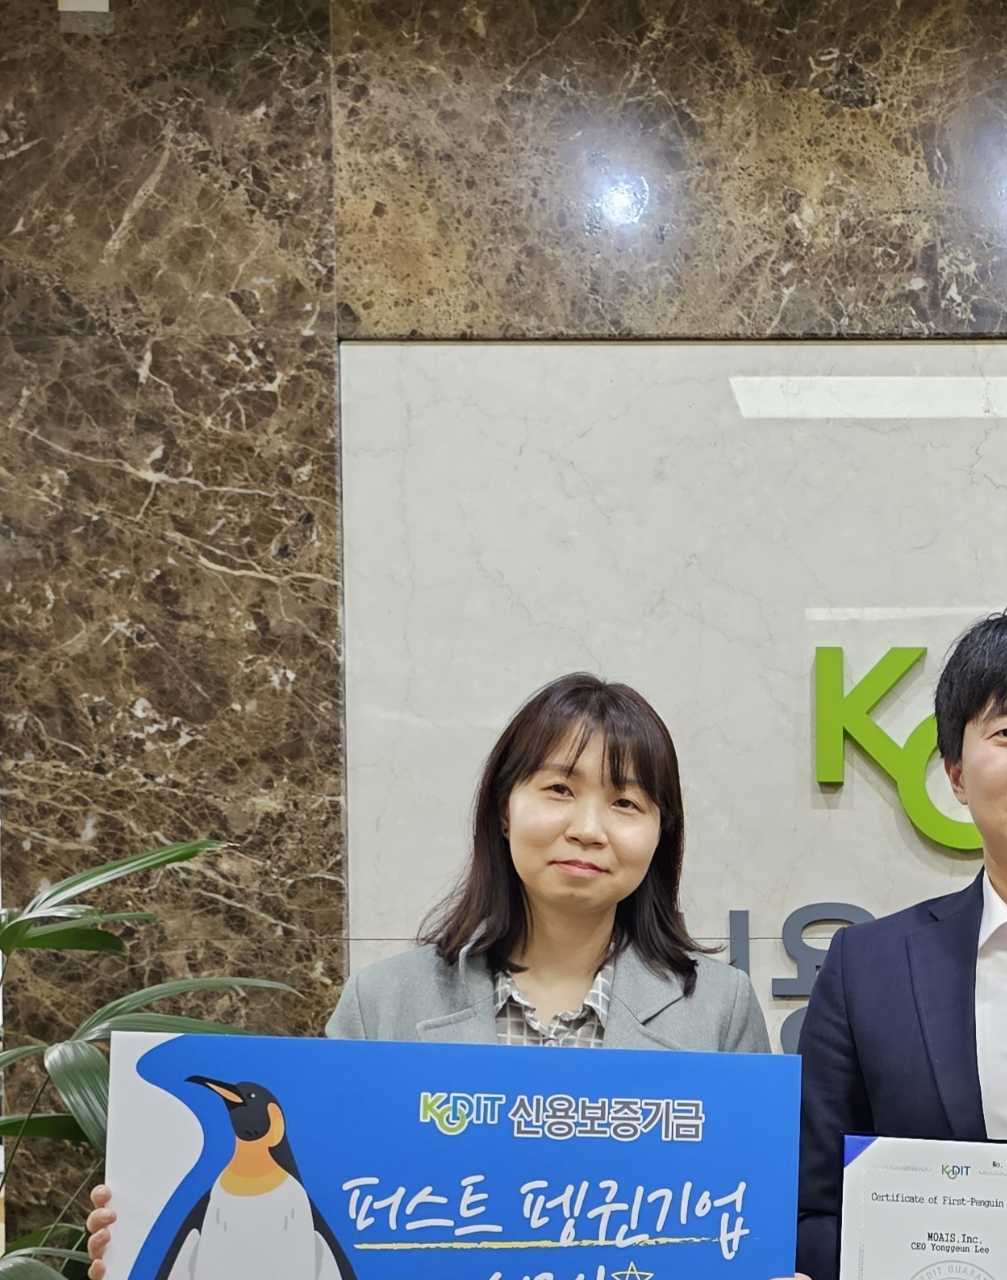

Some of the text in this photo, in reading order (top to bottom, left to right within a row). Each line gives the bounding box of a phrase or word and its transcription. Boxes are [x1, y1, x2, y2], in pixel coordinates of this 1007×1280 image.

[420, 1092, 505, 1136] KODIT
[509, 1094, 705, 1143] 신용보증기금
[941, 1164, 971, 1180] KODIT
[871, 1192, 925, 1205] Certificate
[928, 1196, 938, 1205] of
[942, 1196, 1004, 1209] First-Penguin
[342, 1174, 750, 1261] 퍼스트 펭귄기업
[911, 1242, 927, 1251] CEO
[974, 1245, 990, 1254] Lee
